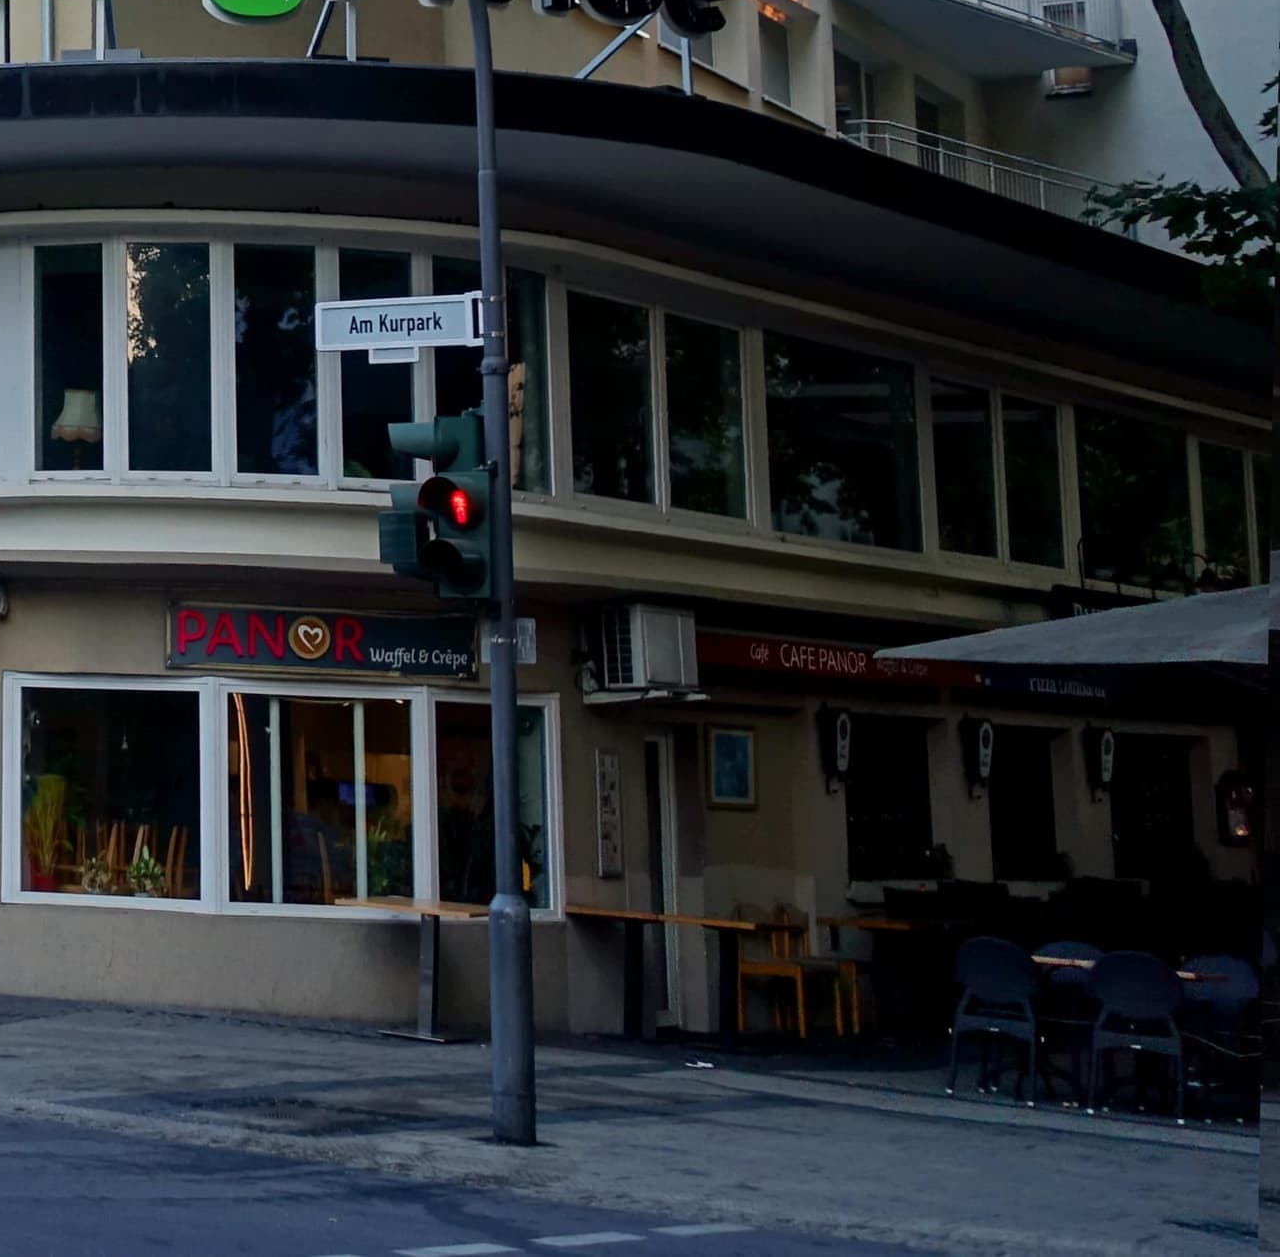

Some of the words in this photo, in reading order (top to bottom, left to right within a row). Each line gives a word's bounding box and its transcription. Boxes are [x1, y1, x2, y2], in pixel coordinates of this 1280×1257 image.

[349, 315, 373, 335] Am
[379, 311, 443, 337] Kurpark
[176, 608, 366, 663] PANOR
[368, 647, 417, 668] Waffel
[418, 649, 429, 664] &
[432, 649, 468, 670] Crêpe
[750, 642, 769, 665] Café
[780, 643, 817, 671] CAFE
[819, 648, 867, 674] PANOR
